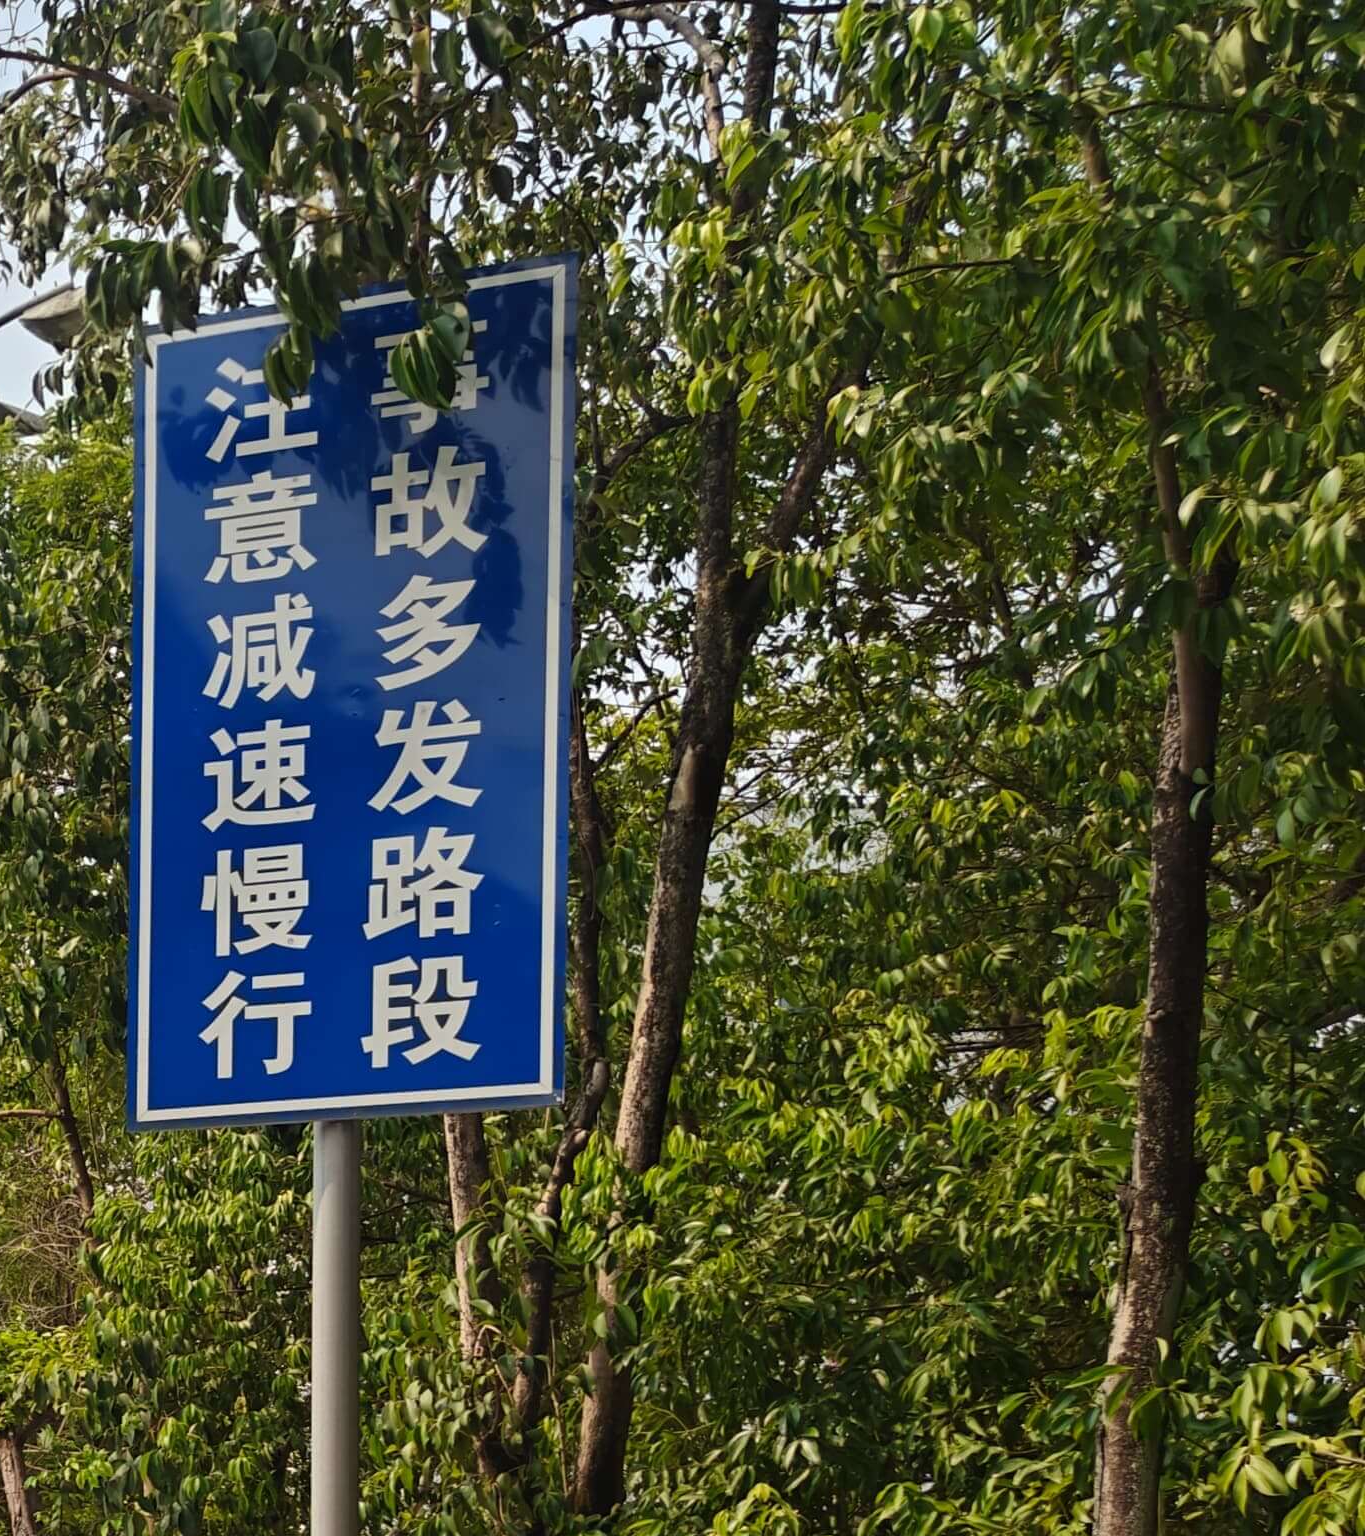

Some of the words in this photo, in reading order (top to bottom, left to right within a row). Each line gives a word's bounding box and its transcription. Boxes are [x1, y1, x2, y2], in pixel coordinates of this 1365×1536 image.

[199, 357, 319, 1079] 注意减速慢行
